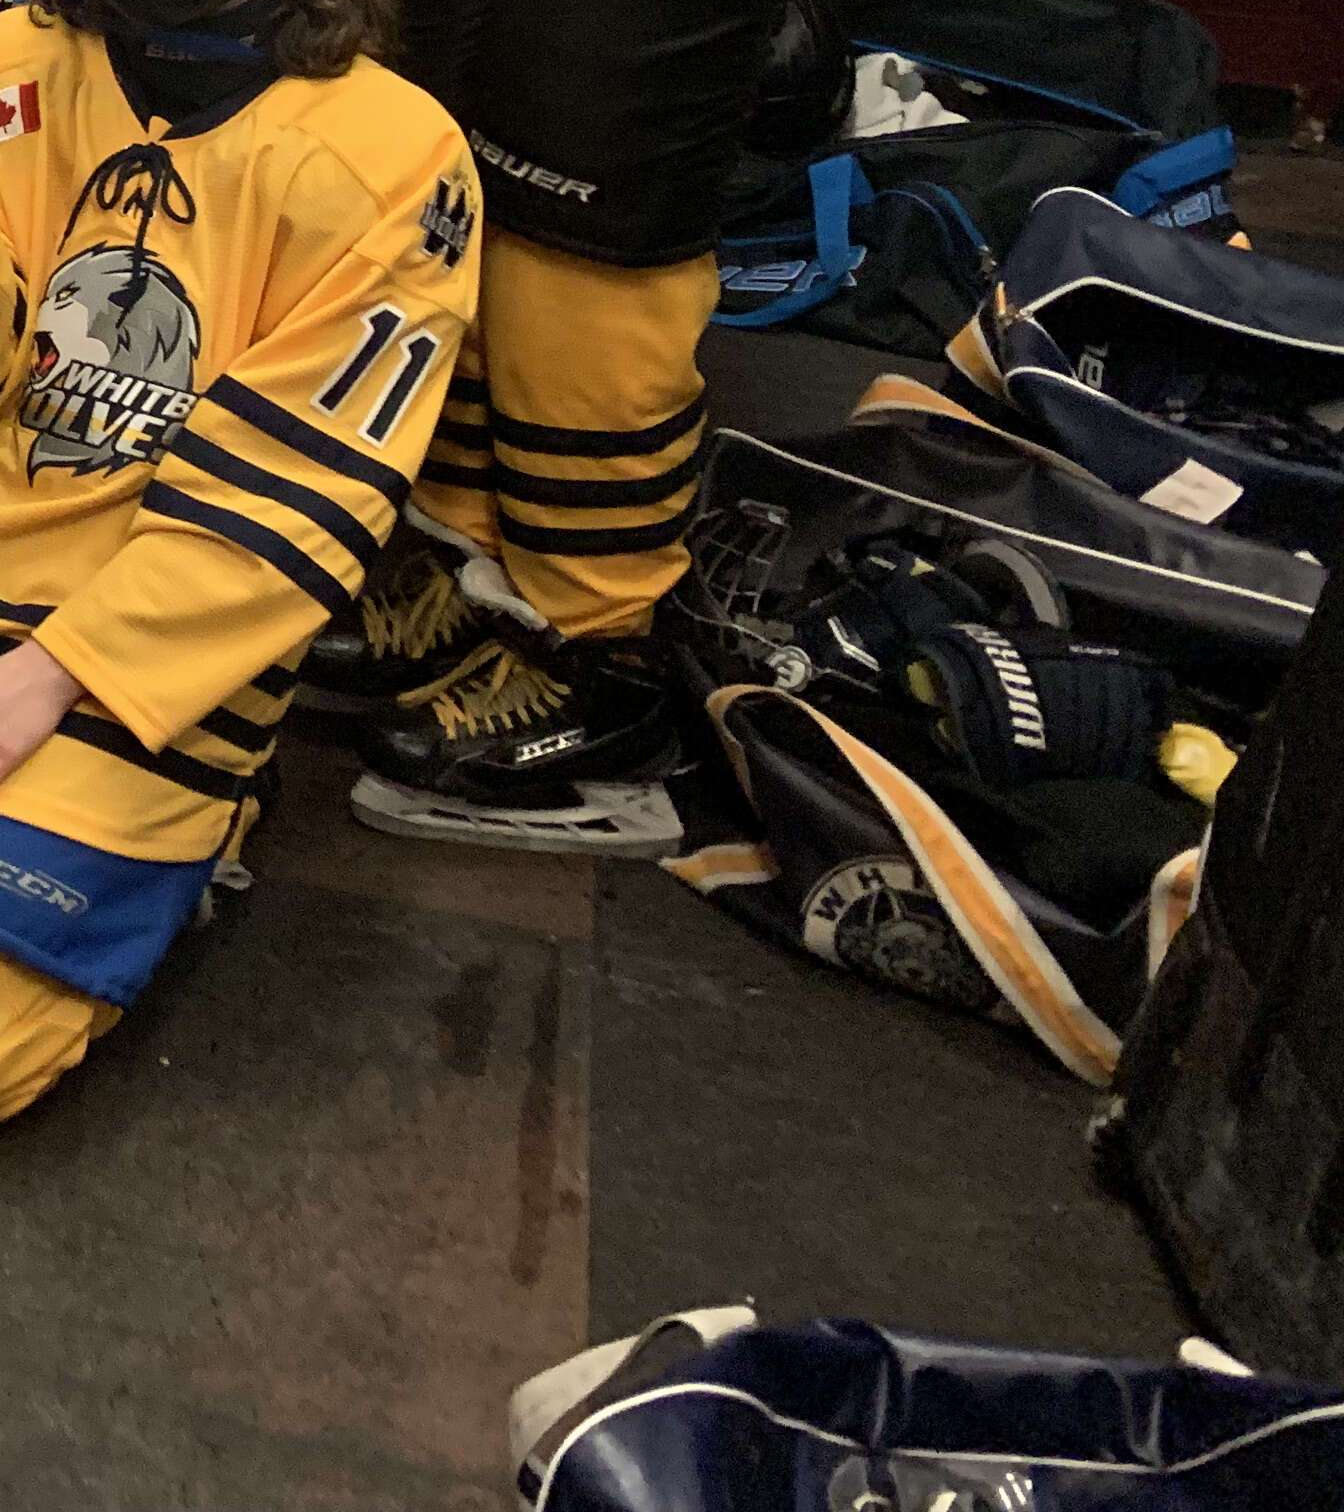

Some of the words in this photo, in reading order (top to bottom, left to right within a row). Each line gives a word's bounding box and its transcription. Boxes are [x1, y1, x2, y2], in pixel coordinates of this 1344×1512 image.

[62, 359, 199, 420] WHITB
[311, 301, 443, 449] 11
[20, 386, 185, 462] OLVE
